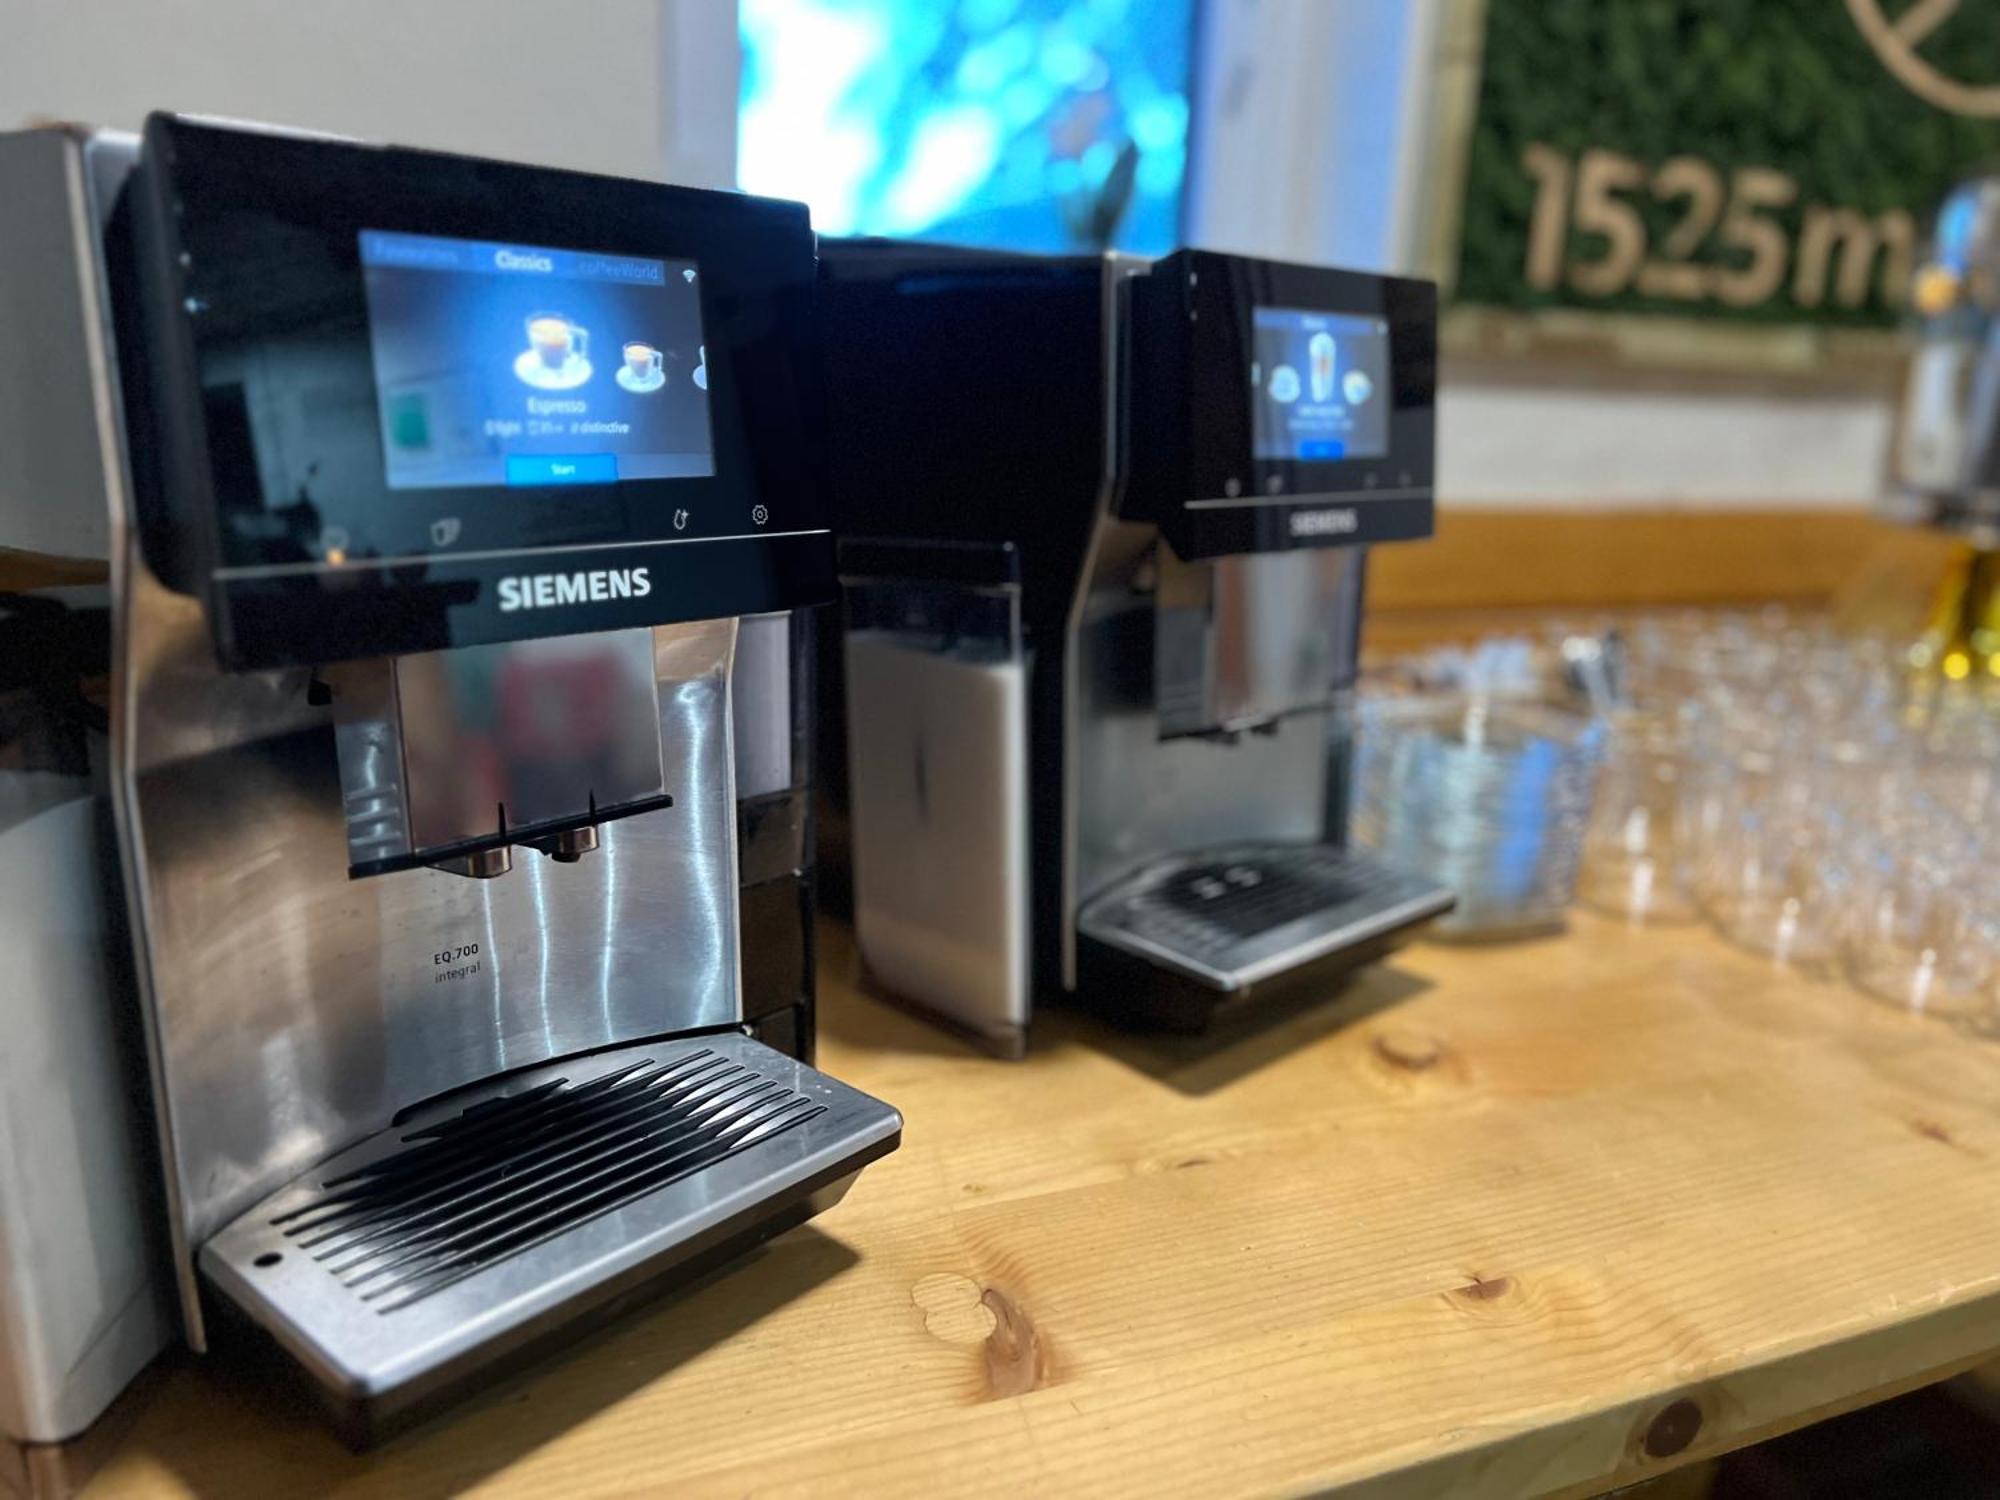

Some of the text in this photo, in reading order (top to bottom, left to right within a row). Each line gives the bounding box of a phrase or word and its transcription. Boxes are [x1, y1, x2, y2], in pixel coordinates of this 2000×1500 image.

[494, 251, 553, 272] Classics
[527, 397, 587, 416] Espresso
[498, 567, 651, 611] SIEMENS
[434, 943, 479, 965] EQ.700
[434, 961, 481, 984] integral
